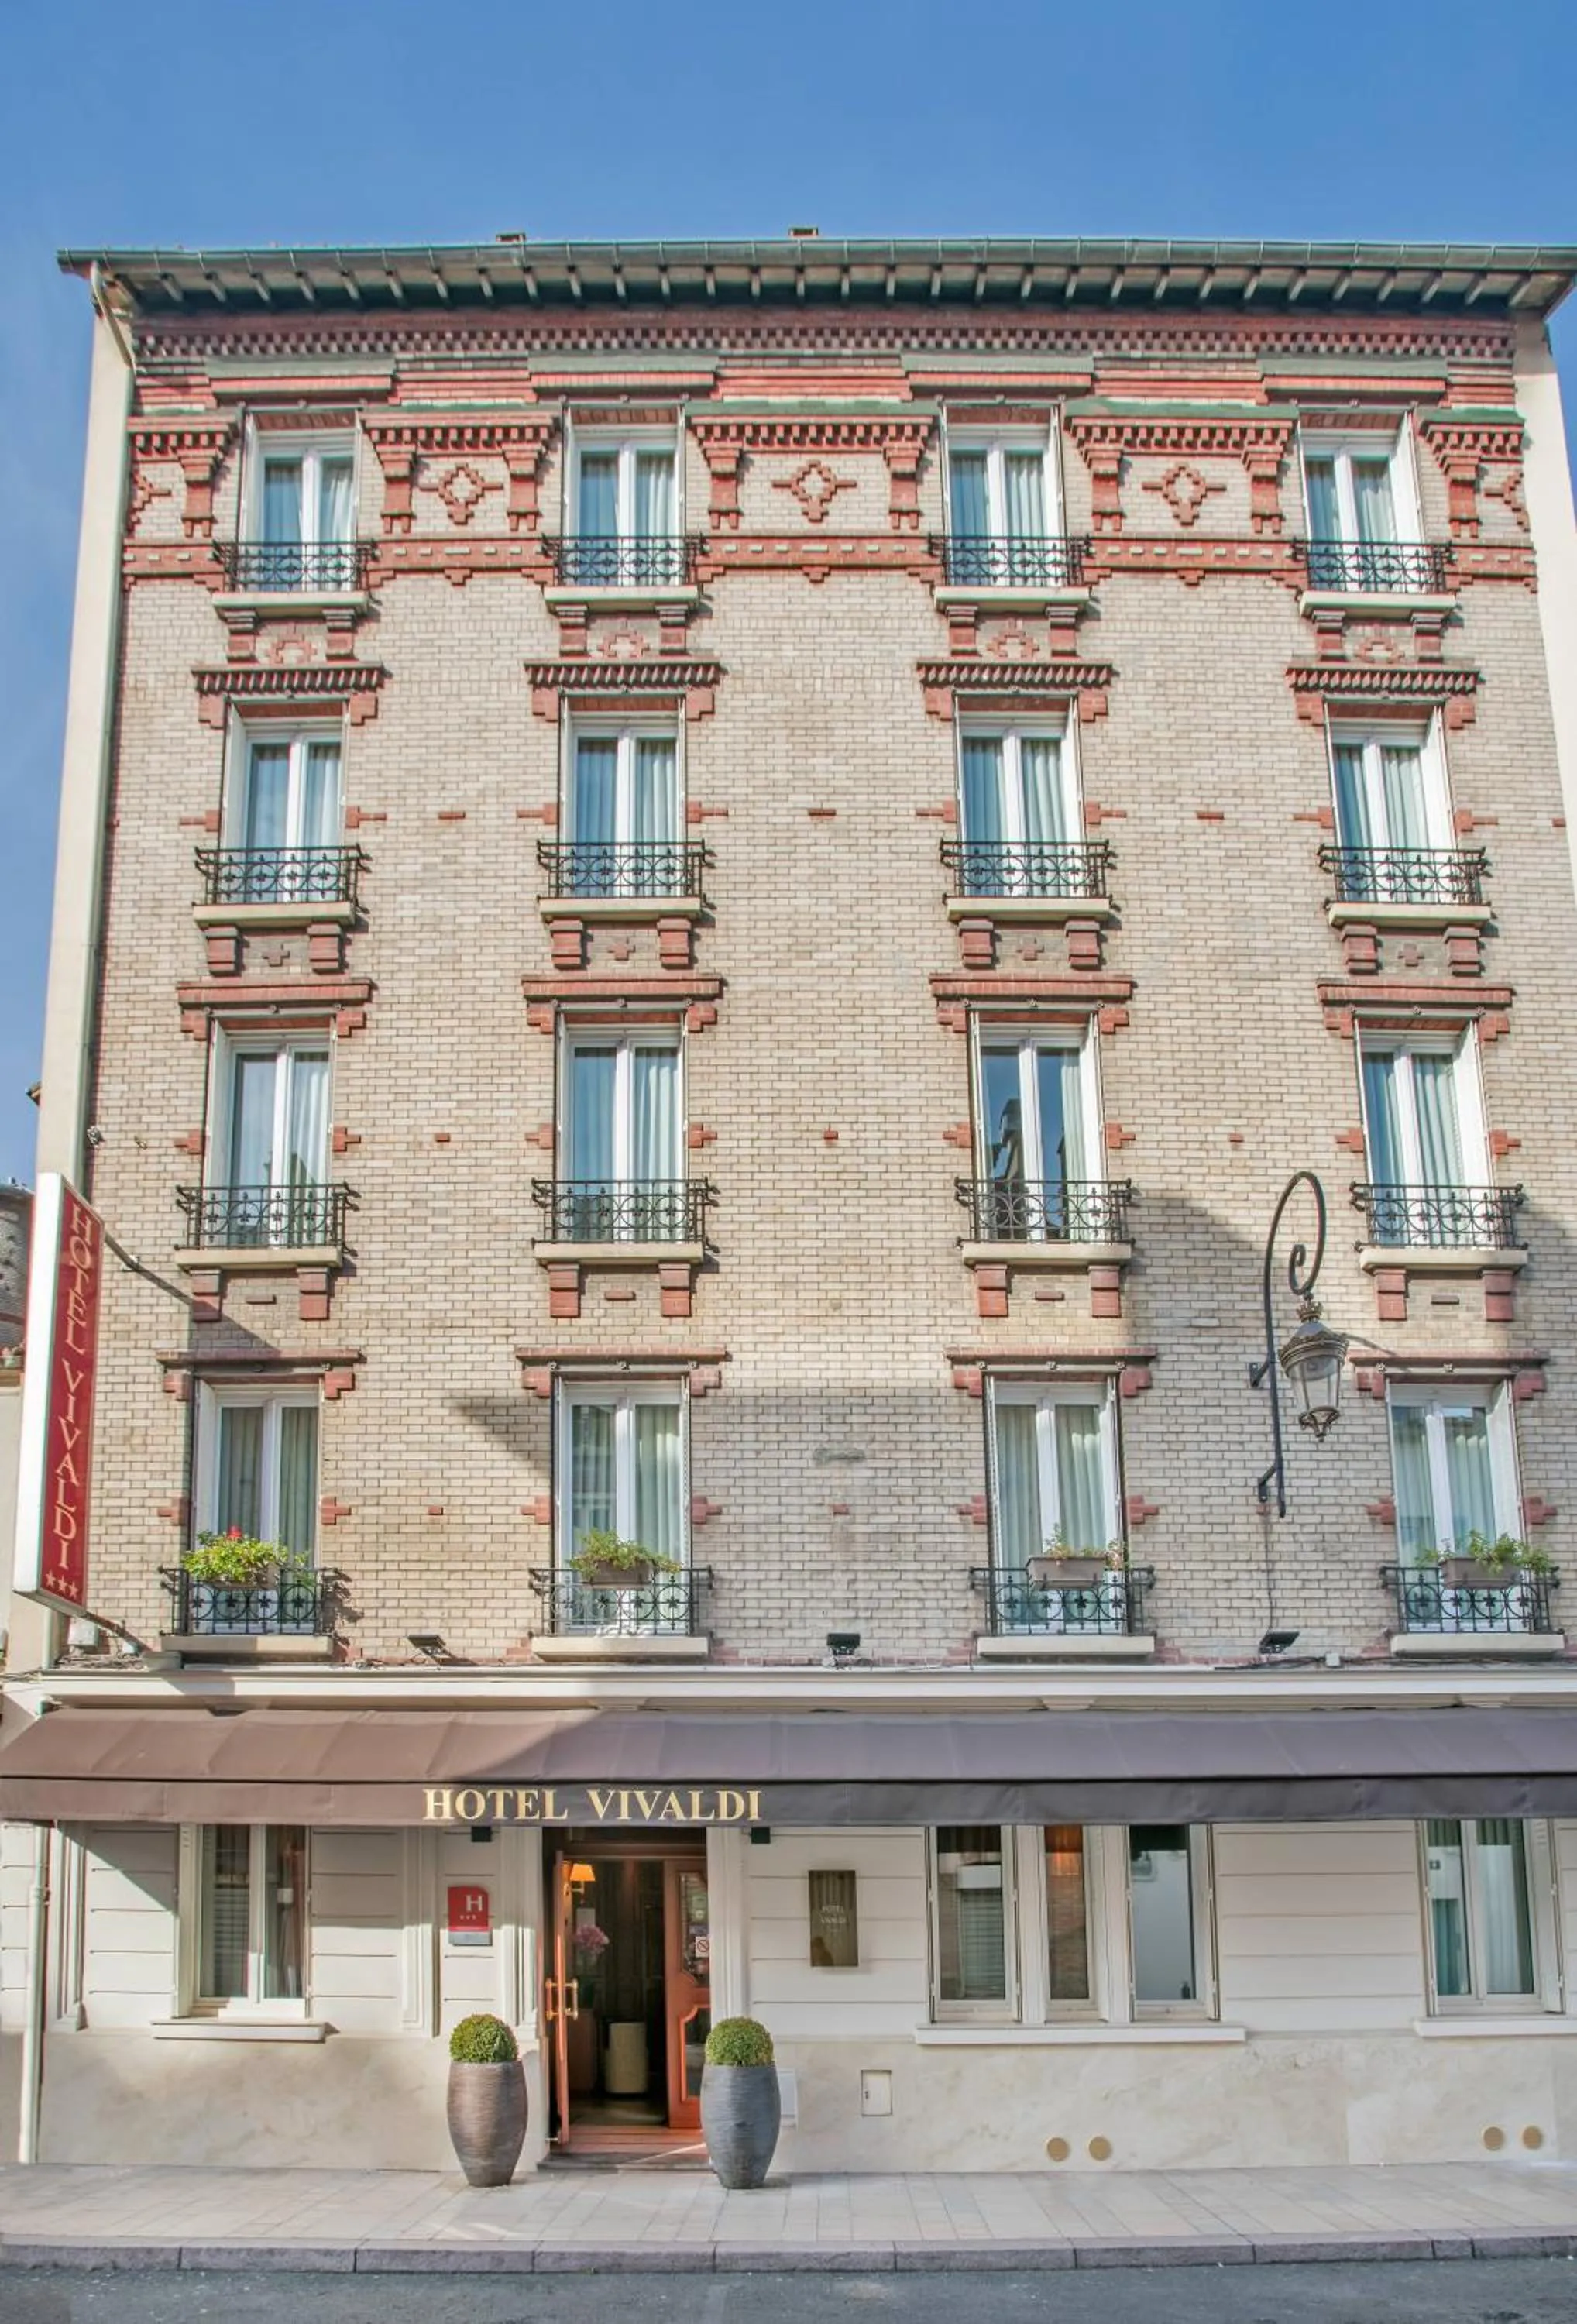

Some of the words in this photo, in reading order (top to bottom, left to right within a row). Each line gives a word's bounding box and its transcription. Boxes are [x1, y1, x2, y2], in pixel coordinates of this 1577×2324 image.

[65, 1202, 93, 1355] HOTEL
[53, 1358, 84, 1569] VIVALDI
[422, 1789, 568, 1820] HOTEL
[586, 1789, 762, 1821] VIVALDI
[466, 1895, 483, 1912] H
